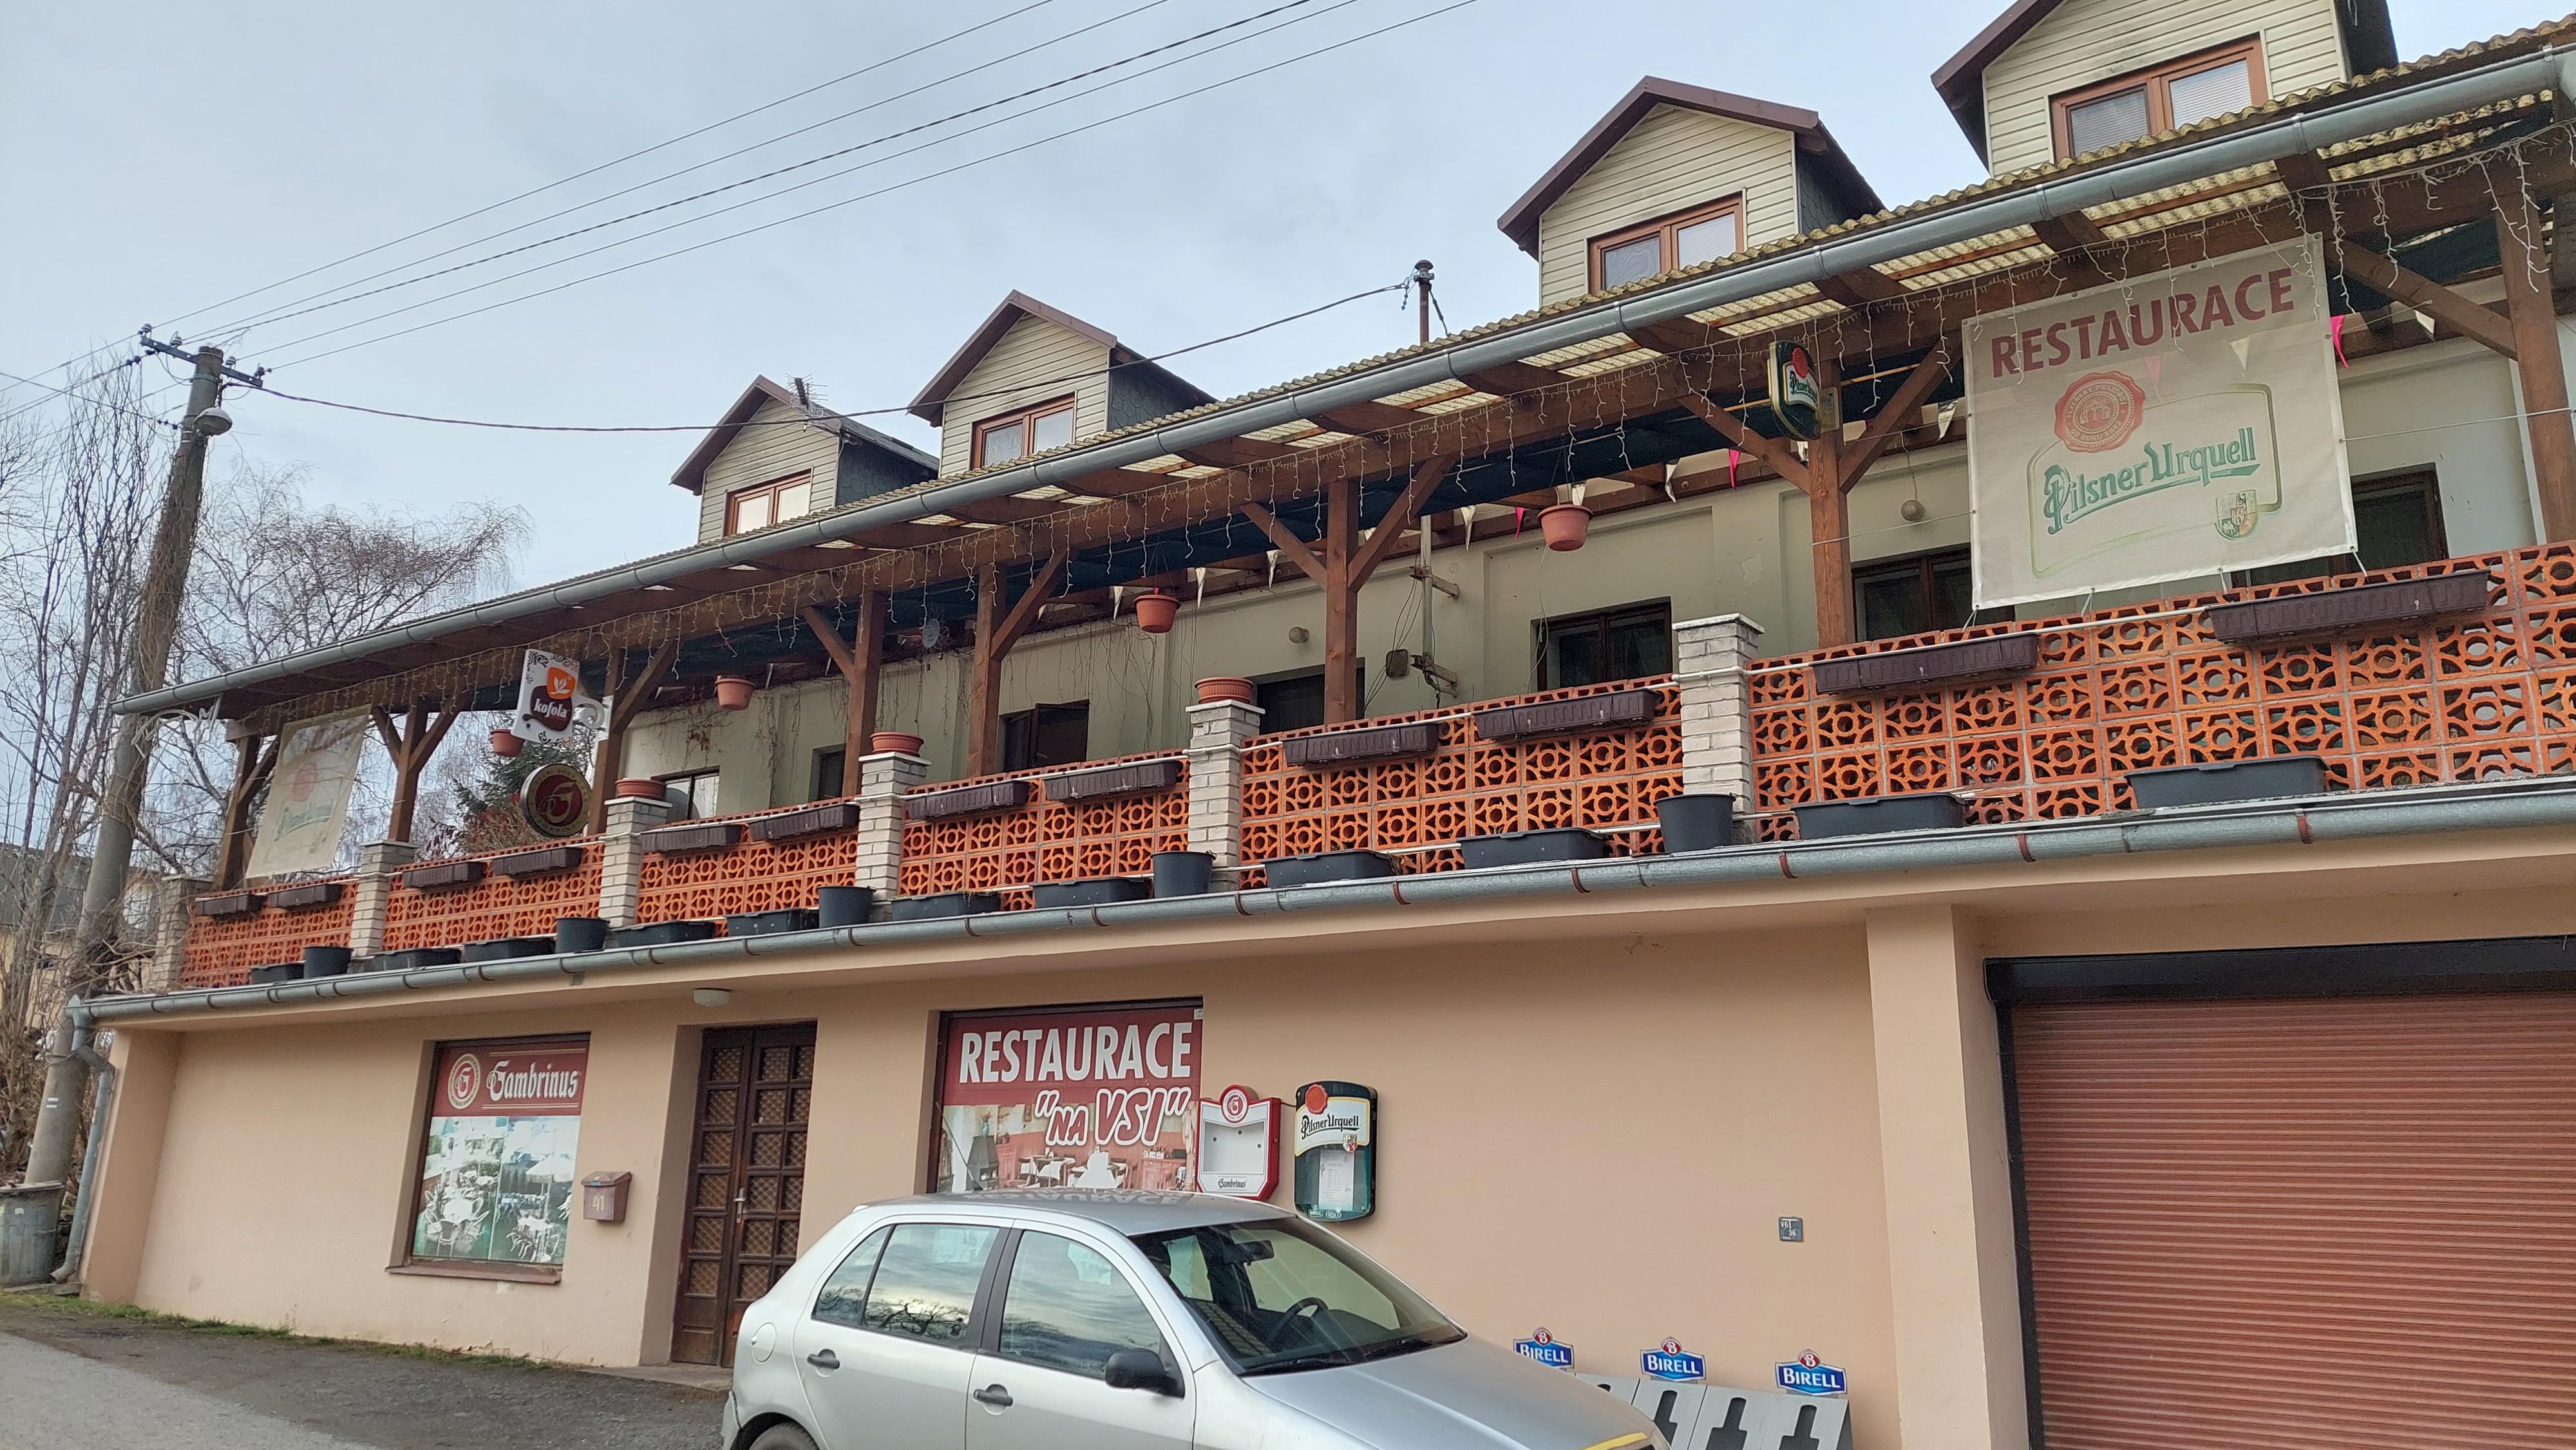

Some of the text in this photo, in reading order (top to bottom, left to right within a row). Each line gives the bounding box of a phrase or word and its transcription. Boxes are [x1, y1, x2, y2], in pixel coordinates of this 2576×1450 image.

[1991, 268, 2295, 378] RESTAURACE
[2043, 426, 2256, 534] Pilsner Urquell
[533, 698, 567, 718] kofola
[959, 1022, 1193, 1084] RESTAURACE
[486, 1060, 580, 1102] Gambrinus
[1301, 1112, 1359, 1140] Pilsner Urquell
[1218, 1178, 1246, 1189] Gambrinus
[592, 1194, 604, 1211] 41
[1520, 1343, 1569, 1364] BIRELL
[1647, 1354, 1700, 1375] BIRELL
[1783, 1367, 1841, 1388] BIRELL
